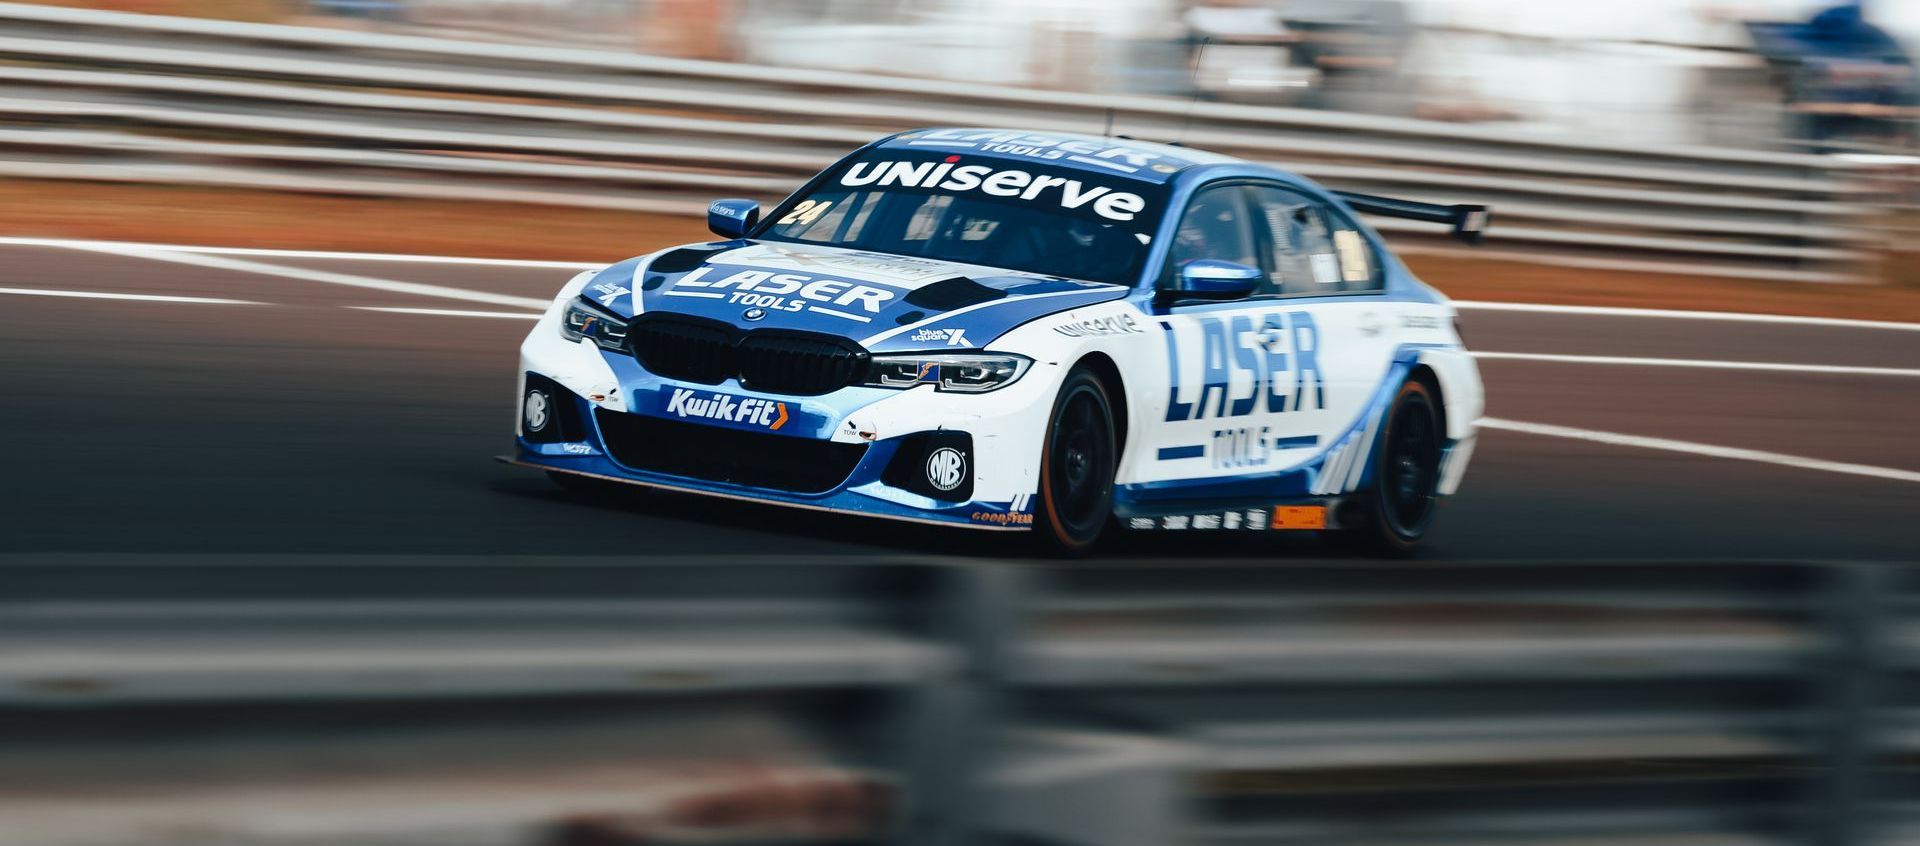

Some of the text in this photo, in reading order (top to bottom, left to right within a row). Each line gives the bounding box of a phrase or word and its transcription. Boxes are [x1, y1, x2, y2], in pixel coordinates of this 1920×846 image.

[980, 142, 1067, 159] TOOLS
[777, 200, 832, 224] 24
[674, 267, 894, 313] LASER
[728, 292, 806, 312] TOOLS
[911, 333, 949, 343] square
[918, 328, 944, 336] blue
[1159, 311, 1324, 422] LASER
[1211, 426, 1270, 469] TOOLS
[930, 450, 962, 486] MB
[972, 511, 1034, 524] GOODYEAR
